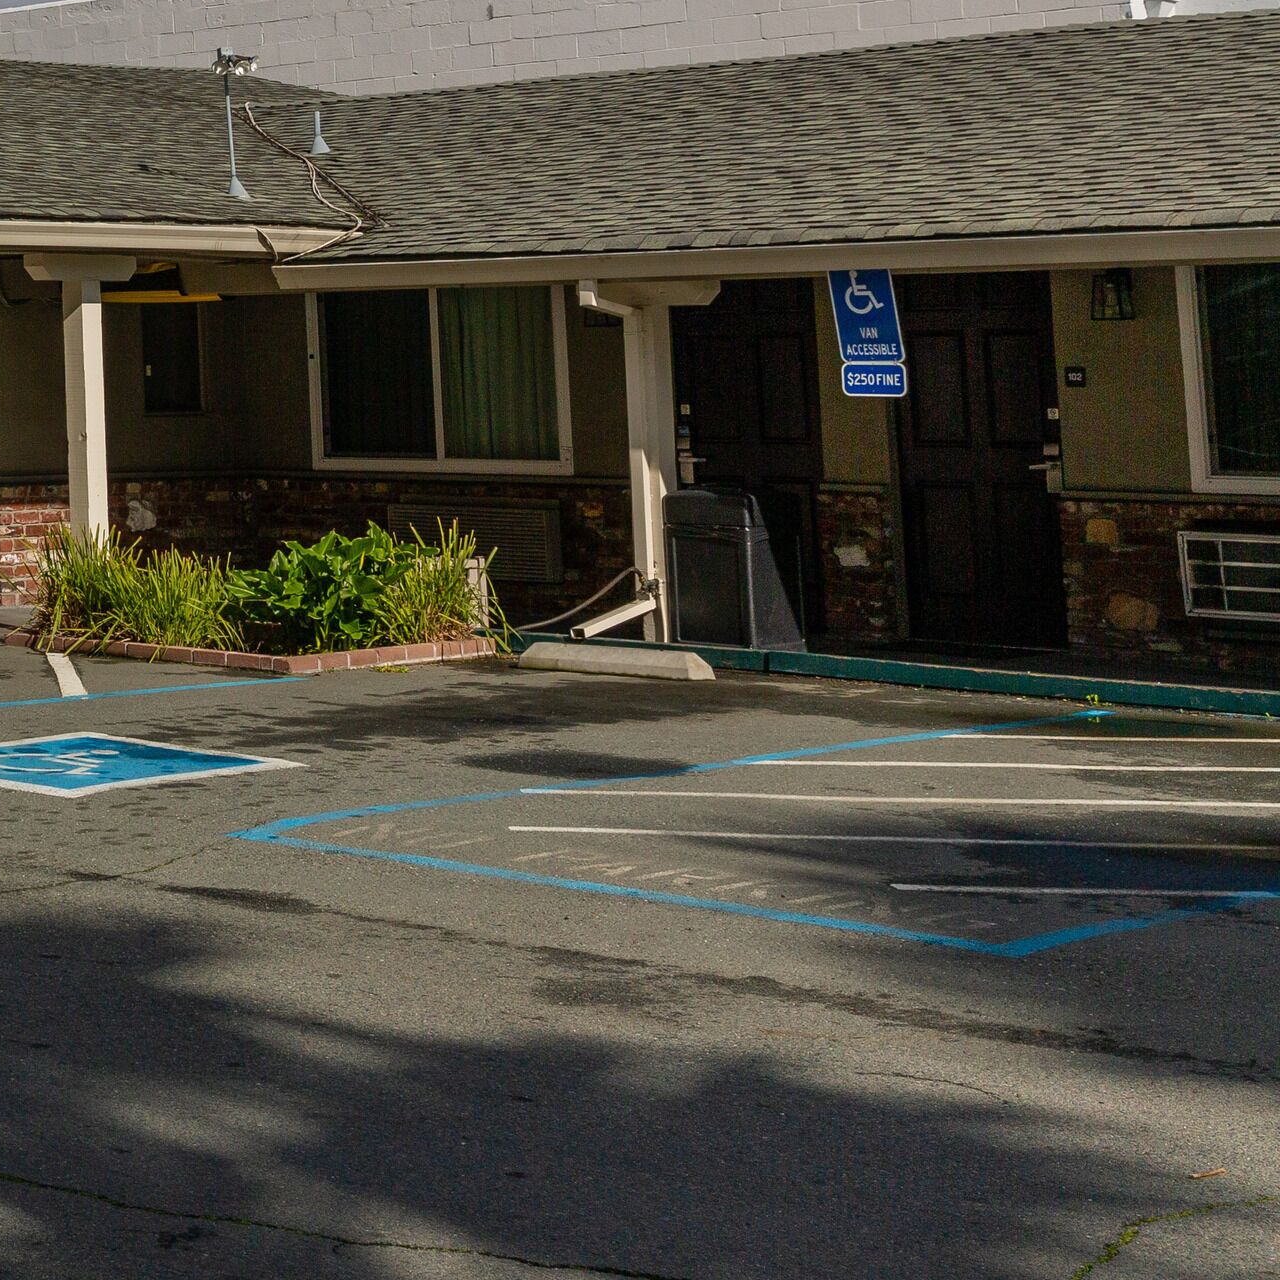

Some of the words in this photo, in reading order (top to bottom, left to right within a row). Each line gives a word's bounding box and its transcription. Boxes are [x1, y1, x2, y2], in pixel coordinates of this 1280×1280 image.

[859, 327, 878, 339] VAN
[847, 343, 898, 356] ACCESSIBLE
[847, 371, 874, 387] $250
[876, 373, 901, 387] FINE
[1067, 372, 1083, 381] 102
